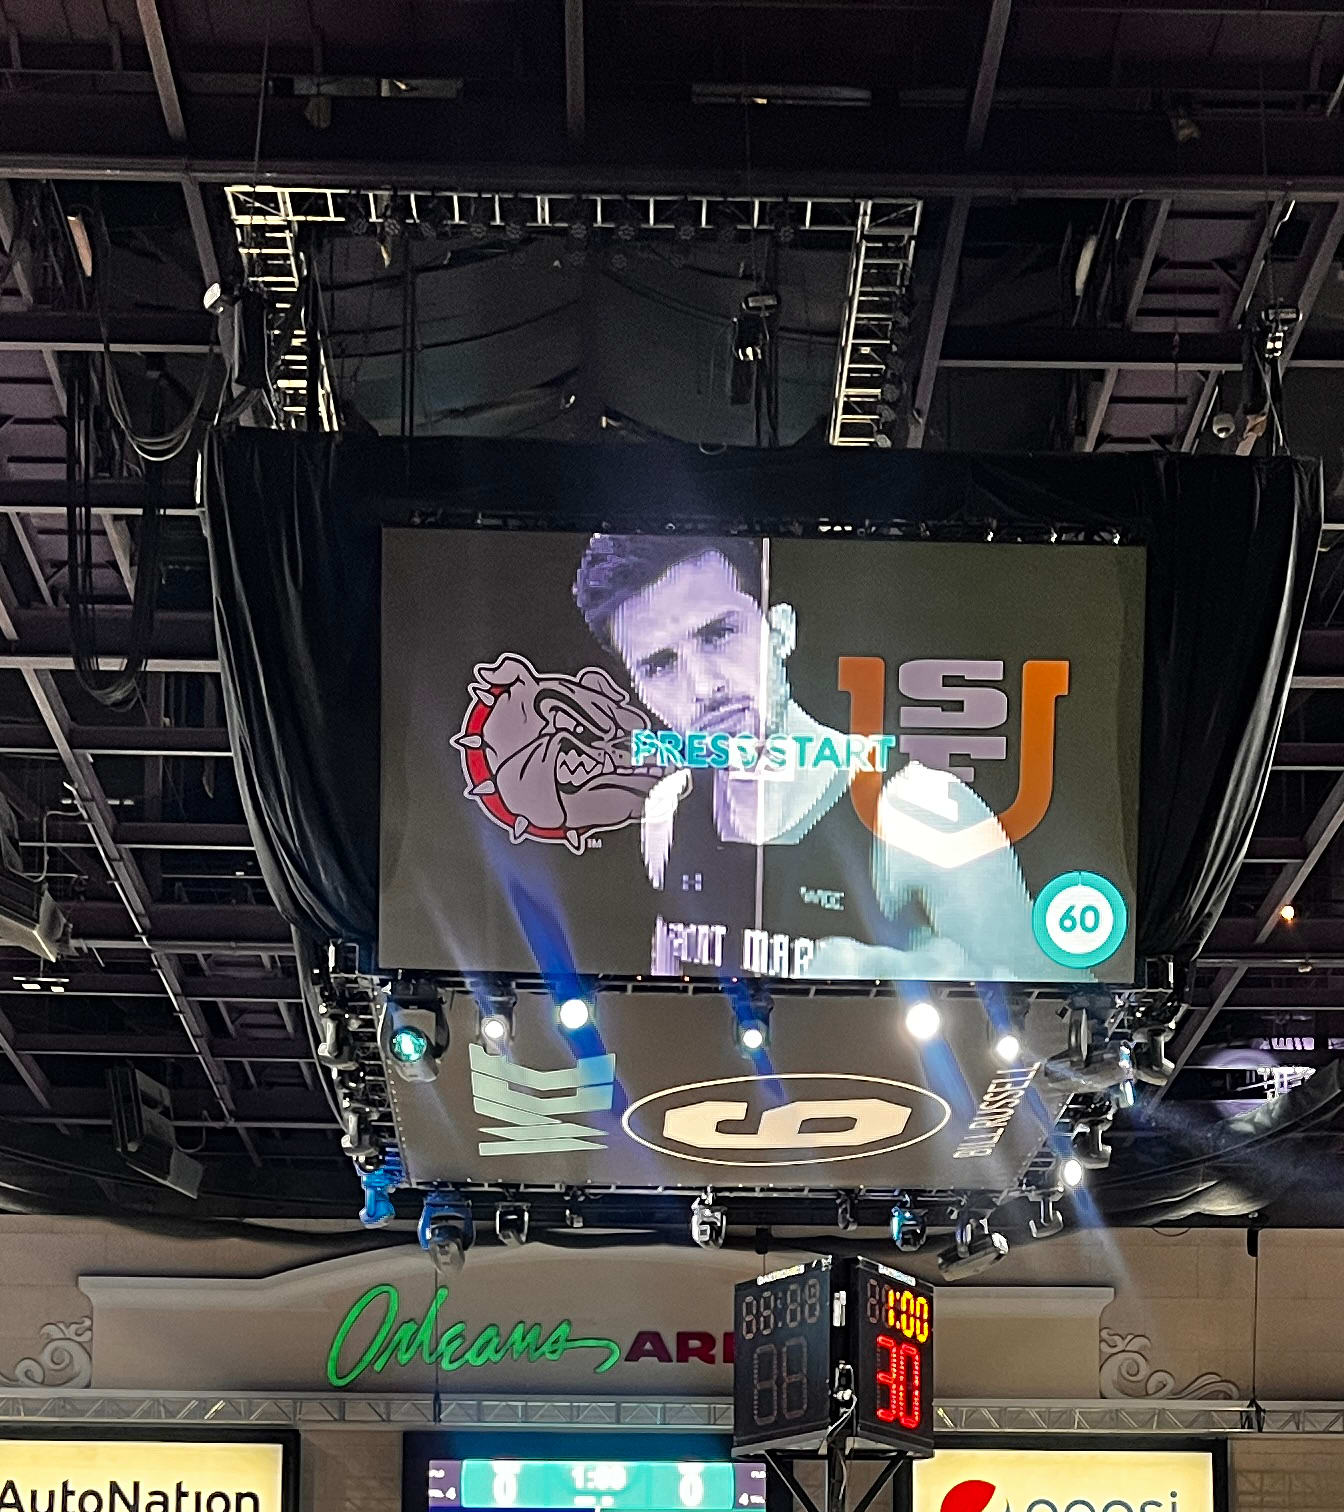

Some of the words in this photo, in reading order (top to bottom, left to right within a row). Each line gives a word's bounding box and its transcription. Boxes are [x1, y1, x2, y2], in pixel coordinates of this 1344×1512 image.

[1058, 905, 1101, 934] 60
[968, 1061, 1042, 1130] RUSSELL
[326, 1284, 621, 1388] Orleans
[887, 1289, 930, 1344] 1:00
[874, 1334, 922, 1430] 30
